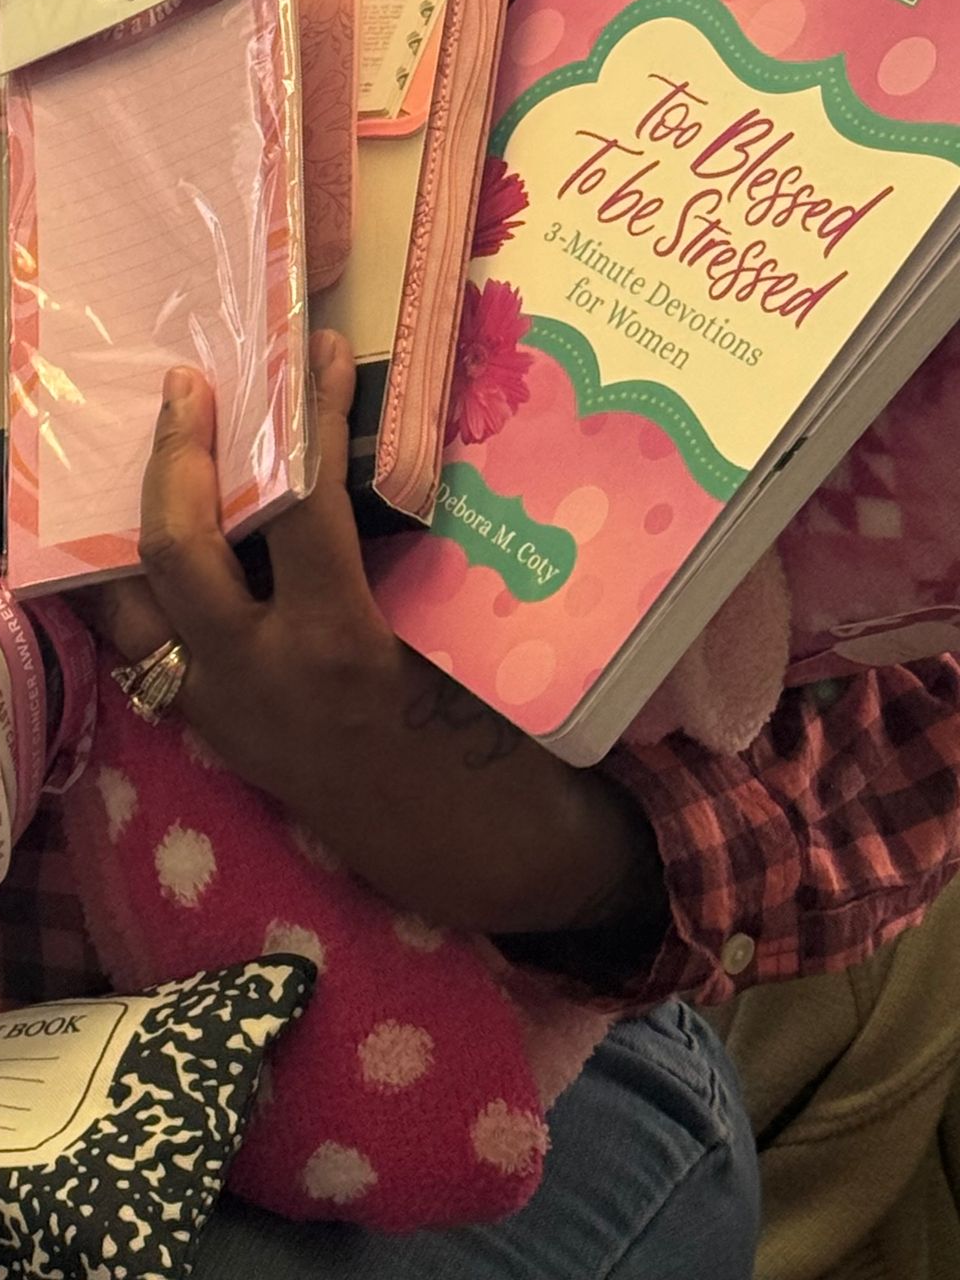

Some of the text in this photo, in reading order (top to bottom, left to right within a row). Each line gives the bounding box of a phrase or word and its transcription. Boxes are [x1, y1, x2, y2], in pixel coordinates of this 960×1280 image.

[635, 73, 894, 259] Too Blessed
[557, 130, 849, 330] To be Stressed
[542, 221, 764, 367] 3-Minute Devotions
[565, 277, 691, 372] for Women
[433, 482, 561, 585] Debora M. Coty
[4, 1014, 87, 1040] BOOK
